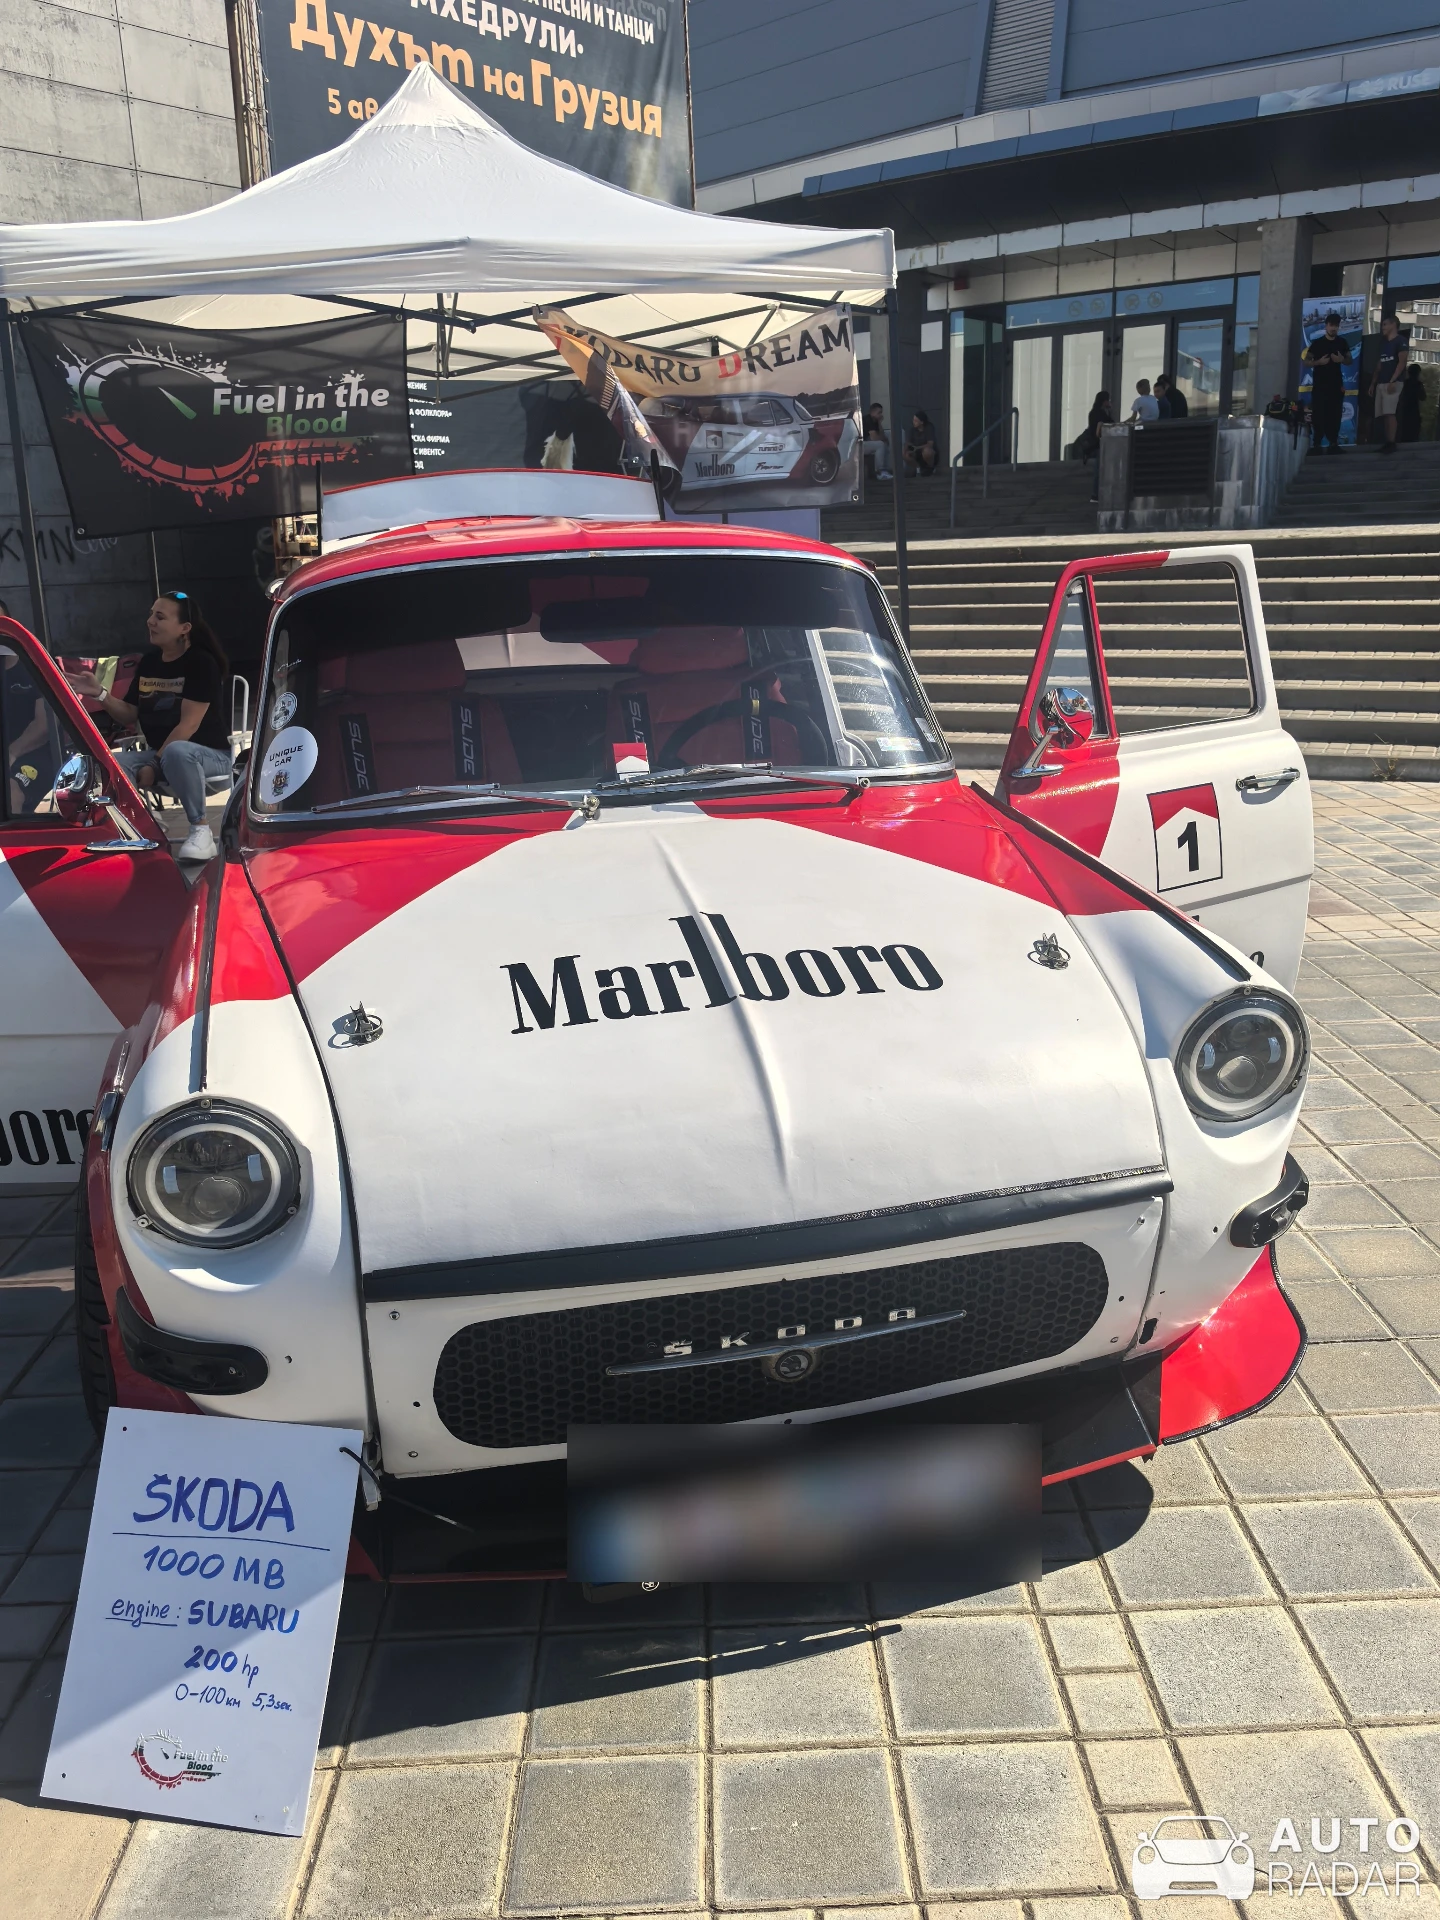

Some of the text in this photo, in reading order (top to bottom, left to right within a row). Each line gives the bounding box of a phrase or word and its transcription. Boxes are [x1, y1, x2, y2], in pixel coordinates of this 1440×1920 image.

[593, 4, 604, 28] И
[605, 7, 654, 45] ТАНЦИ
[289, 0, 662, 138] Духът на Грузия
[327, 88, 341, 115] 5
[717, 317, 850, 378] DREAM
[213, 378, 390, 415] Fuel in the
[266, 410, 348, 437] Blood
[426, 435, 450, 444] ФИРМА
[694, 453, 735, 477] Marlboro
[460, 705, 475, 776] SLIDE
[628, 699, 644, 743] SLI
[749, 686, 764, 755] SIDE
[269, 744, 303, 762] UNIQUE
[274, 756, 292, 768] CAR
[348, 721, 370, 791] SLIDE
[1177, 821, 1199, 872] 1
[499, 911, 944, 1035] Marlboro
[132, 1473, 295, 1533] ŠKODA
[143, 1545, 285, 1590] 1000 MB
[187, 1599, 300, 1634] SUBARU
[184, 1645, 259, 1688] 200 hp
[173, 1747, 228, 1762] Fuel in the
[187, 1760, 213, 1771] Blood
